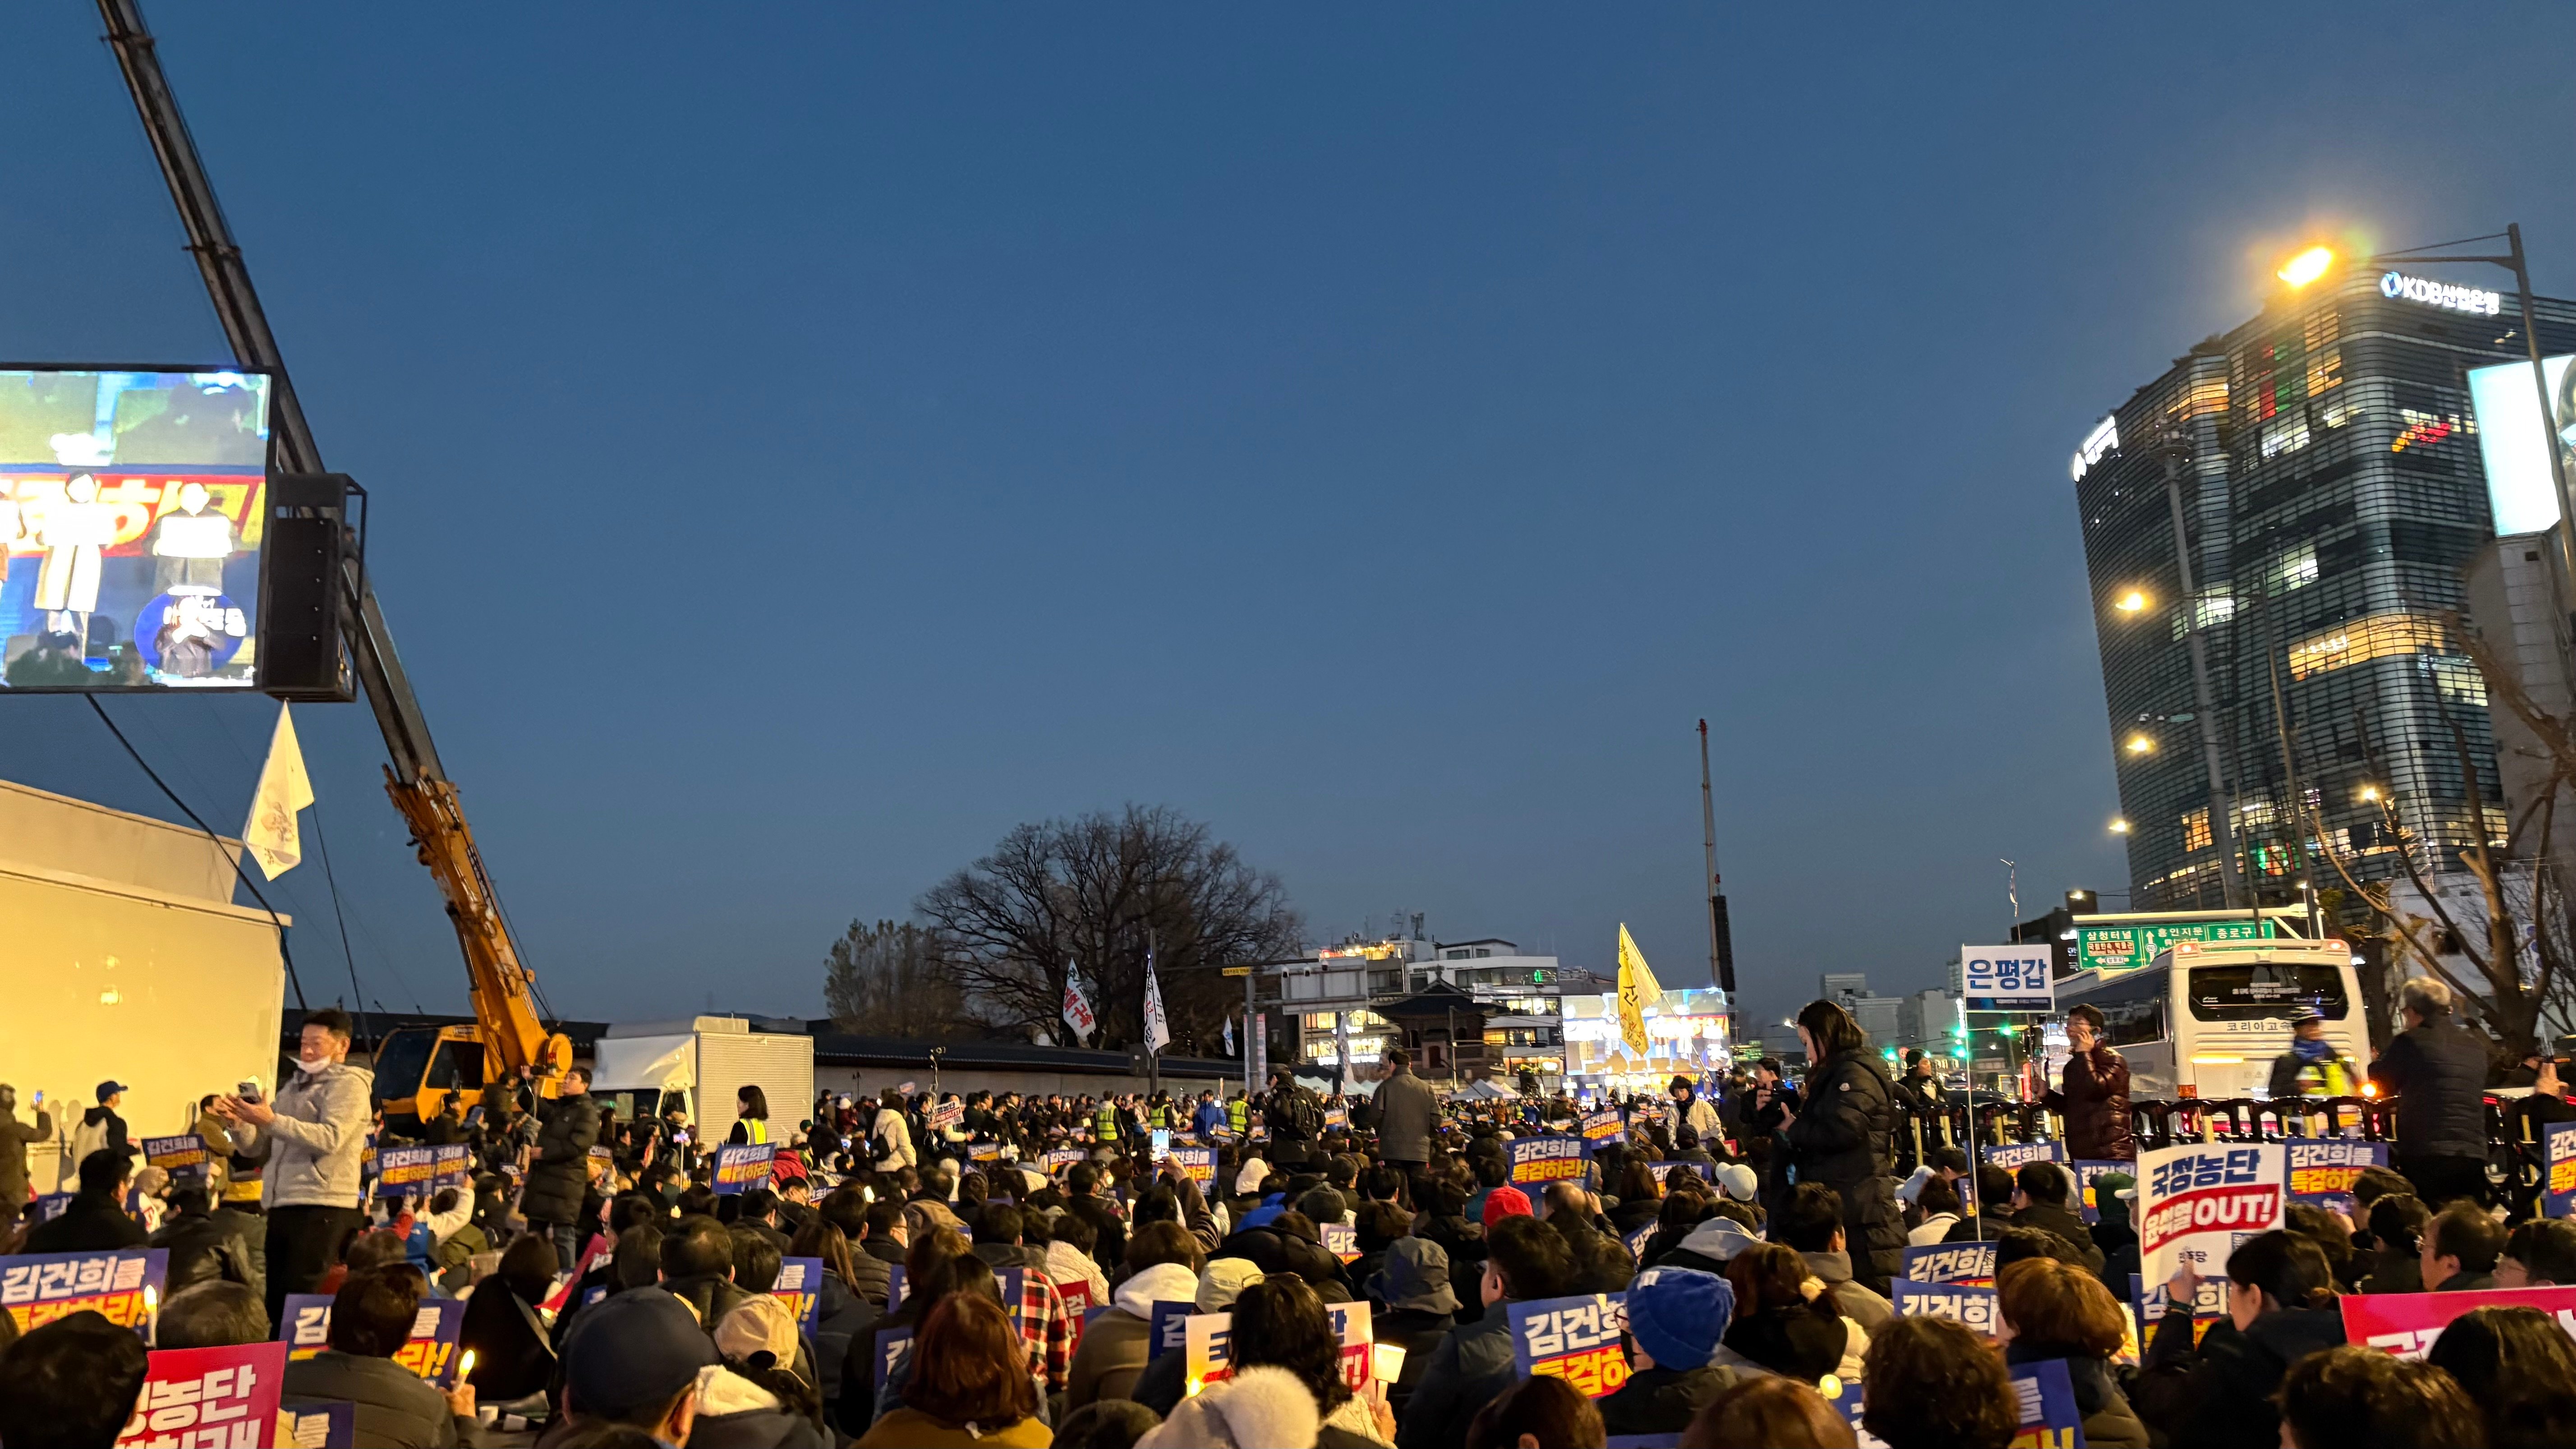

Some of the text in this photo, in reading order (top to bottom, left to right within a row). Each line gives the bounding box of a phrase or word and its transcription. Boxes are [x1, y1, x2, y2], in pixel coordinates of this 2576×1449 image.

[2087, 930, 2132, 941] 삼청터널
[2158, 927, 2203, 938] 흥인지문
[1967, 959, 2047, 990] 은평갑
[1514, 1139, 1581, 1163] 김건희를
[1992, 1145, 2053, 1167] 김건희를
[2290, 1144, 2374, 1168] 김건희를
[1512, 1159, 1590, 1182] 특검하라!
[2152, 1149, 2261, 1197] 국정농단
[2145, 1193, 2275, 1248] 윤석열 OUT!
[1, 1256, 146, 1304] 김건희를
